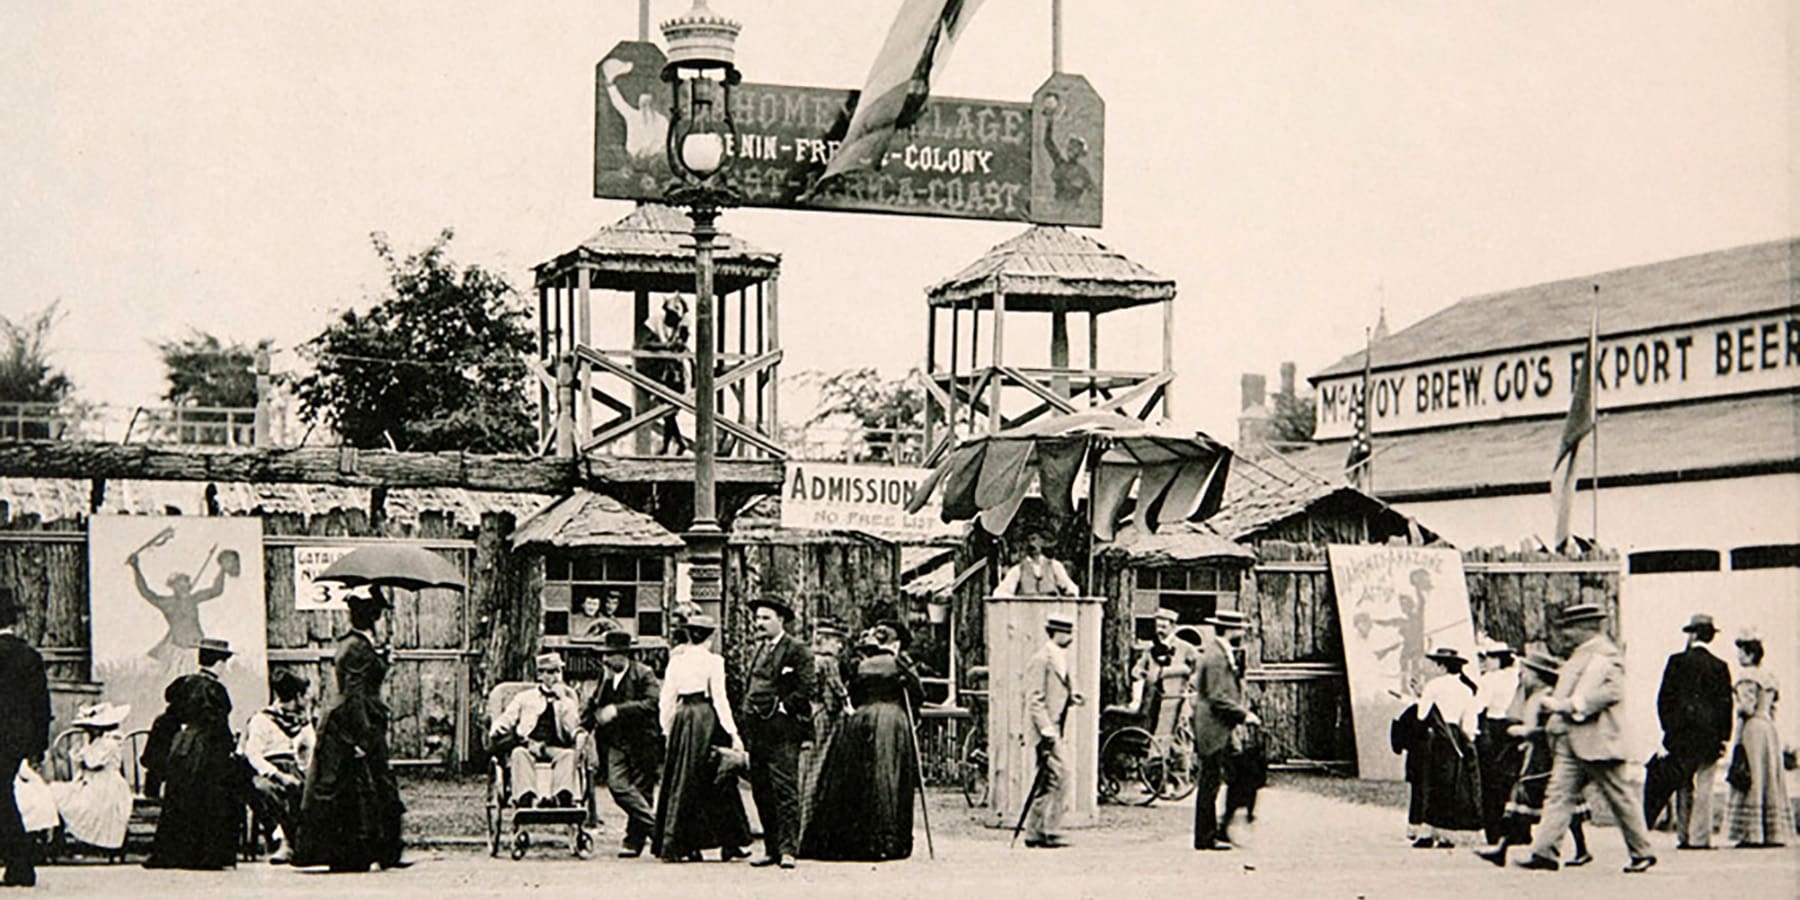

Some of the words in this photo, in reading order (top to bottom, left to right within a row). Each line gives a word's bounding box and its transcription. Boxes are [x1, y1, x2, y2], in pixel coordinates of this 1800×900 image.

[1416, 365, 1486, 413] BREW.
[1716, 319, 1800, 376] BEER
[791, 467, 916, 506] ADMISSION
